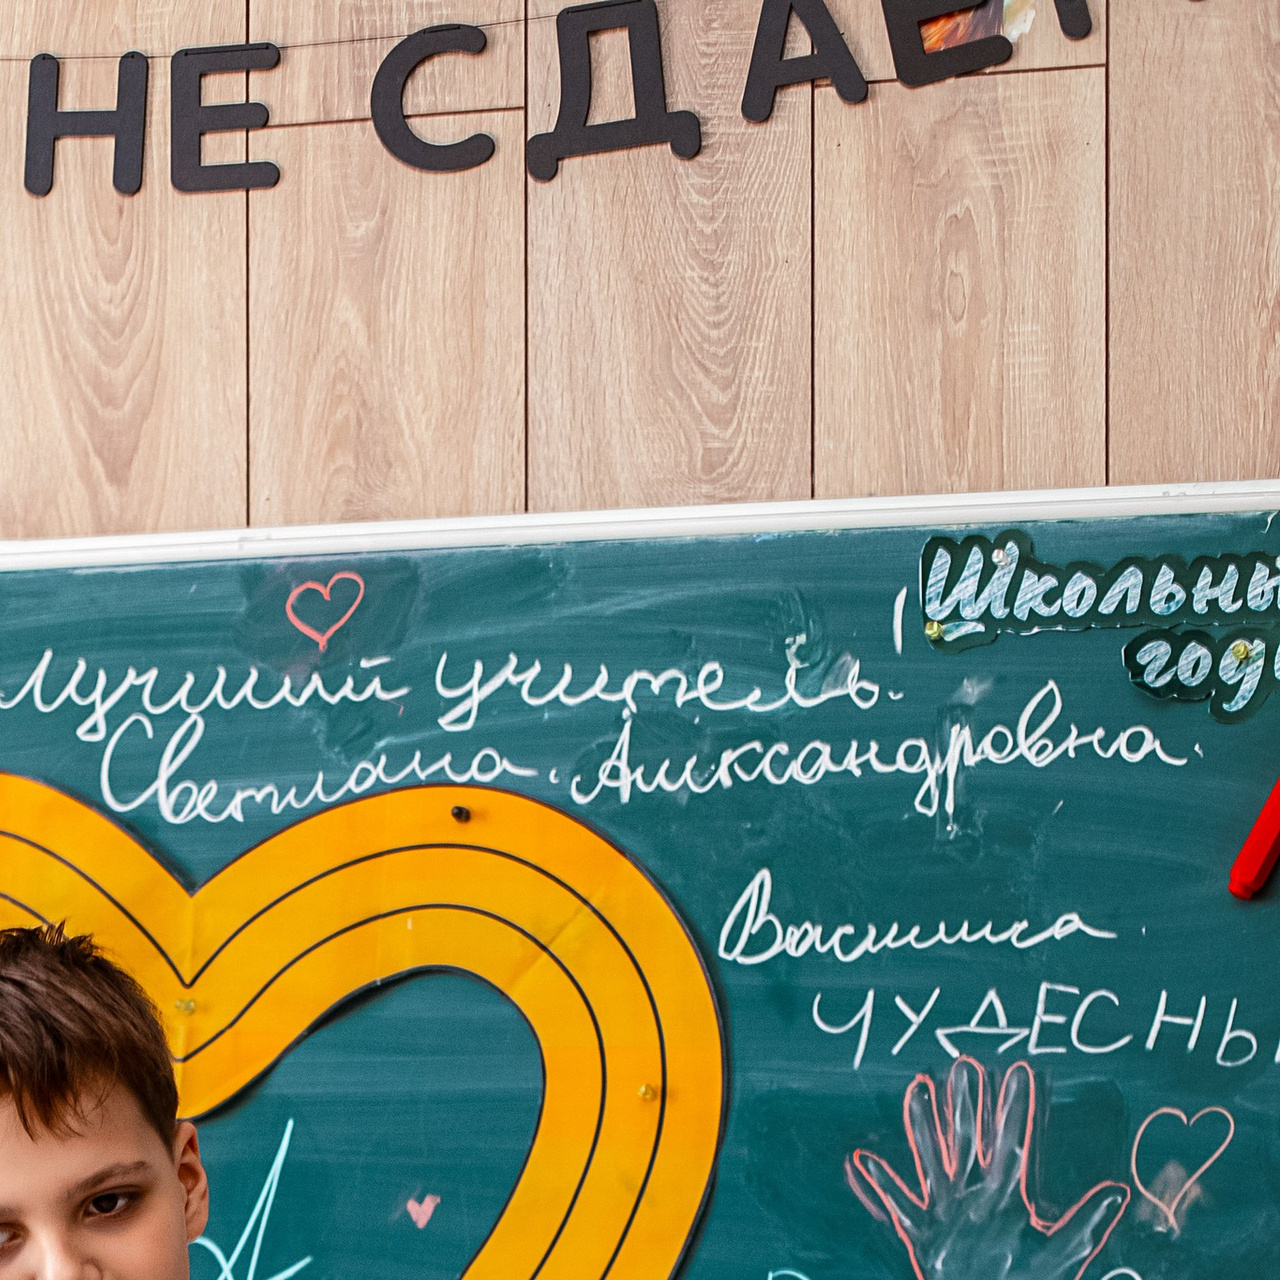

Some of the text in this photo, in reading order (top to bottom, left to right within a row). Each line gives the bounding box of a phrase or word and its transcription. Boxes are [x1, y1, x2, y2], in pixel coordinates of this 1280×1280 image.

[23, 42, 281, 197] НЕ
[369, 0, 1093, 184] СДАЕ
[1136, 637, 1280, 713] год
